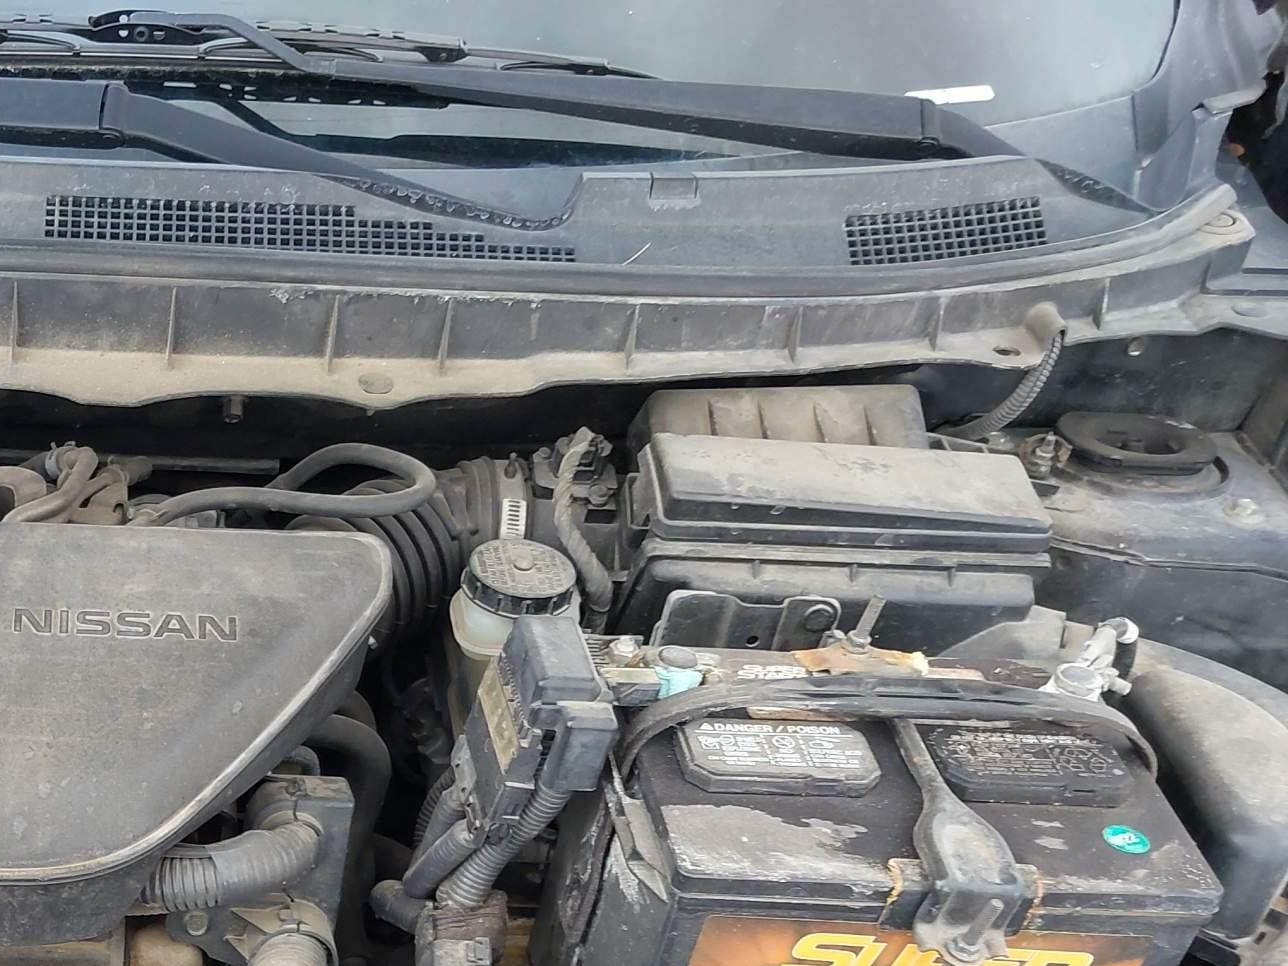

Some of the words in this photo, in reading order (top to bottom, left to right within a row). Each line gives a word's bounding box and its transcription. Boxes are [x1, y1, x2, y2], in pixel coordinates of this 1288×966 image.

[12, 607, 238, 642] NISSAN
[713, 722, 773, 733] DANGER
[786, 725, 841, 734] POISON
